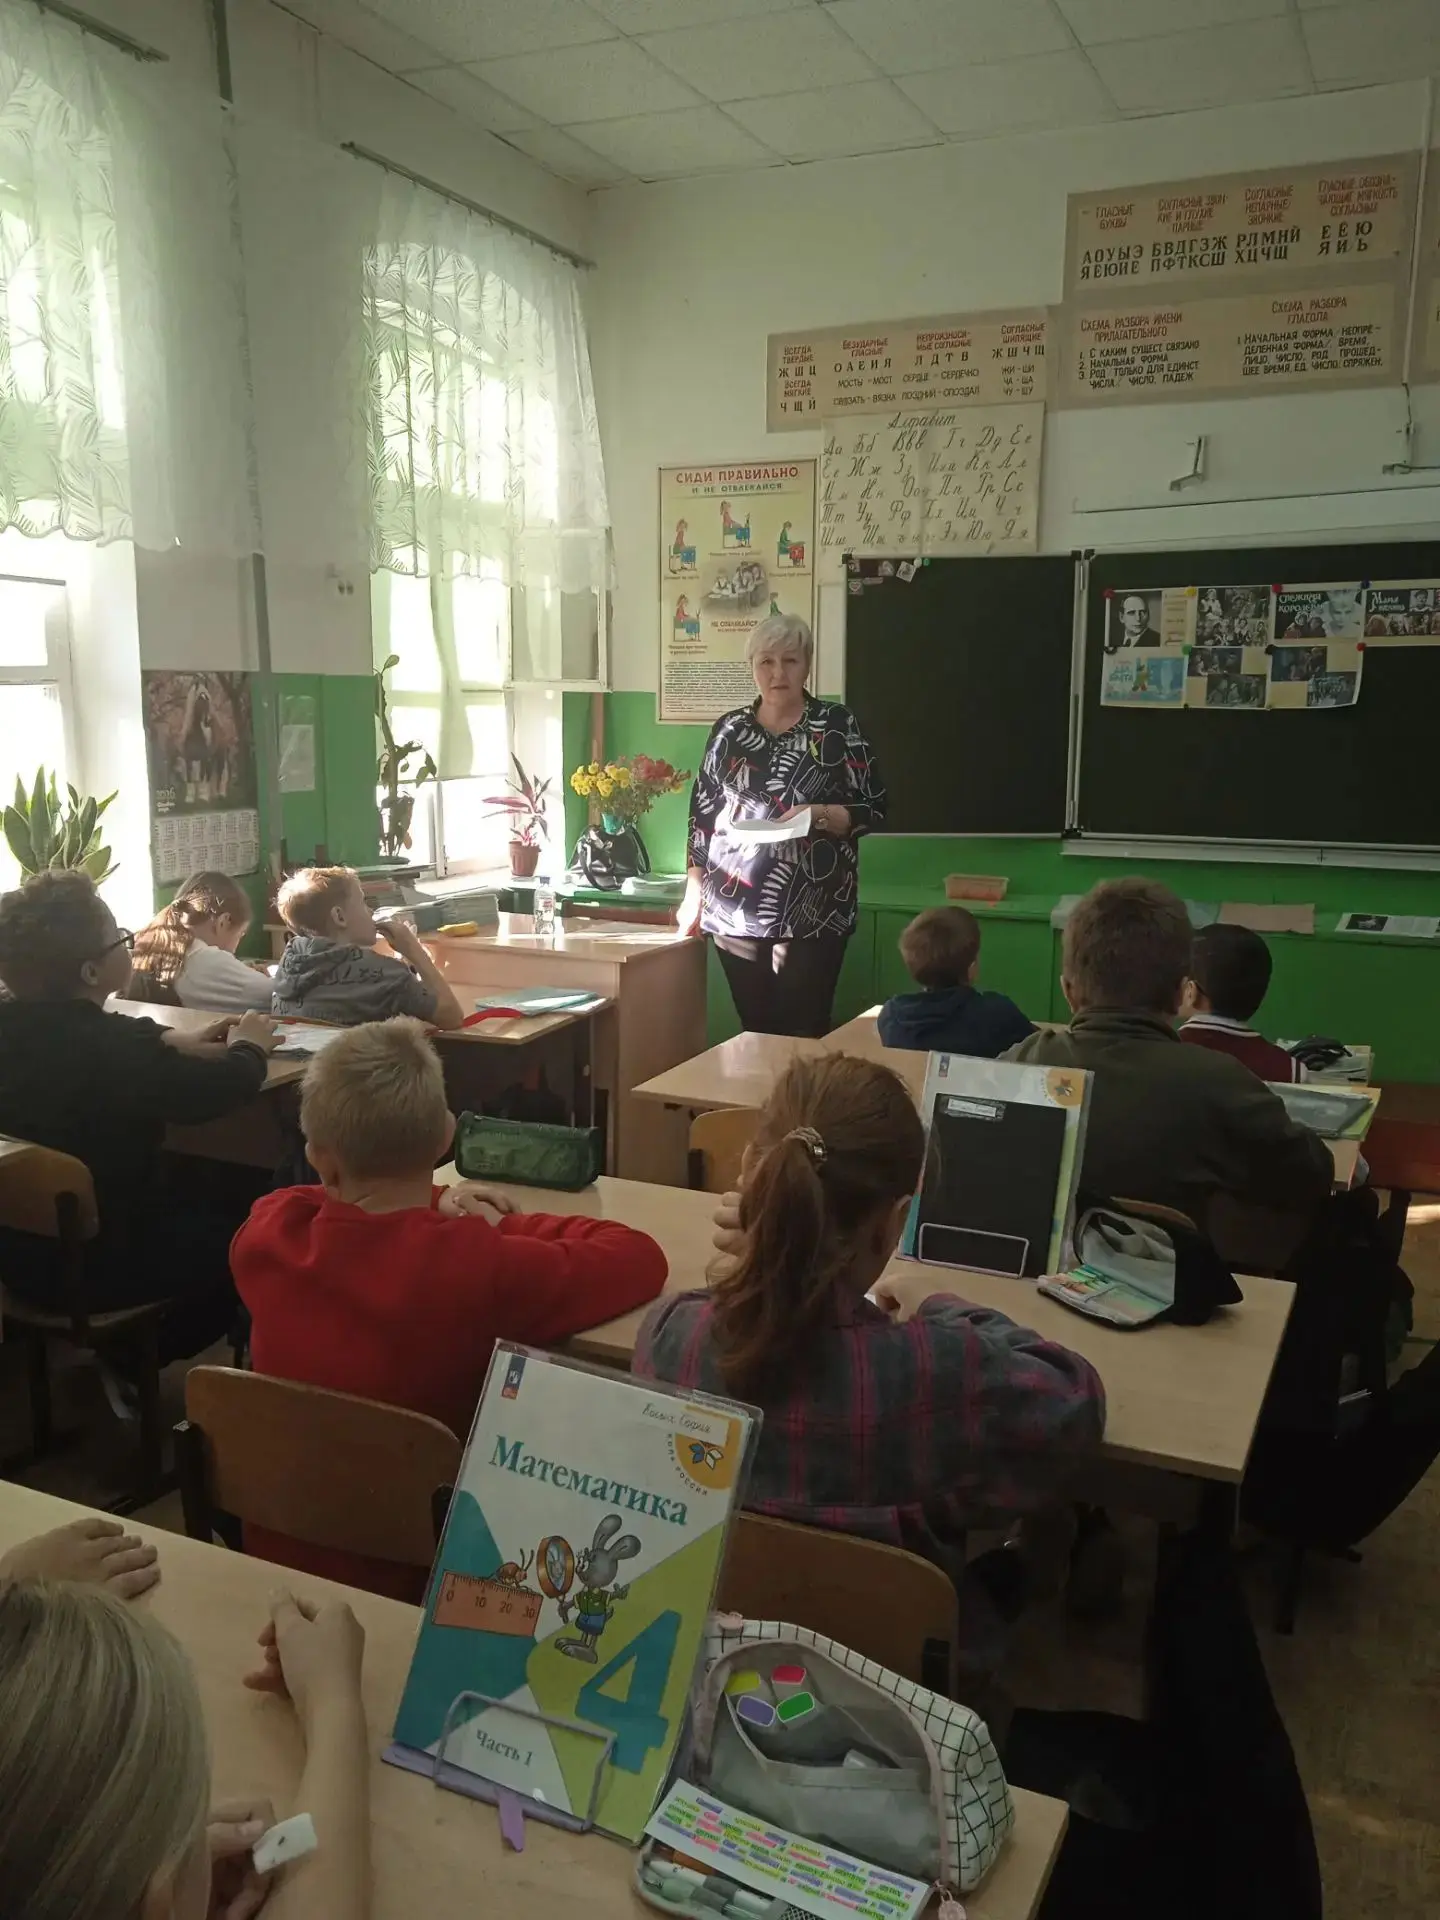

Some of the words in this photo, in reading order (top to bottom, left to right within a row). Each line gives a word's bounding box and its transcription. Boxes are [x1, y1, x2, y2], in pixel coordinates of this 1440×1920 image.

[1272, 300, 1303, 314] СХЕМА
[1114, 315, 1150, 329] РАЗБОРА
[1152, 311, 1183, 325] ИМЕНИ
[1001, 323, 1046, 335] СОГЛАСНЫЕ
[784, 345, 812, 356] ВСЕГДА
[992, 348, 1003, 359] Ж
[1099, 345, 1127, 358] КАКИМ
[1141, 352, 1169, 364] ФОРМА
[1147, 363, 1165, 375] ДЛЯ
[1162, 371, 1194, 384] ПАДЕЖ
[784, 379, 812, 390] ВСЕГДА
[676, 470, 713, 484] СИДИ
[719, 466, 799, 481] ПРАВИЛЬНО
[488, 1433, 689, 1527] Математика
[474, 1596, 487, 1609] 10
[575, 1609, 683, 1776] 4
[476, 1729, 522, 1763] Часть
